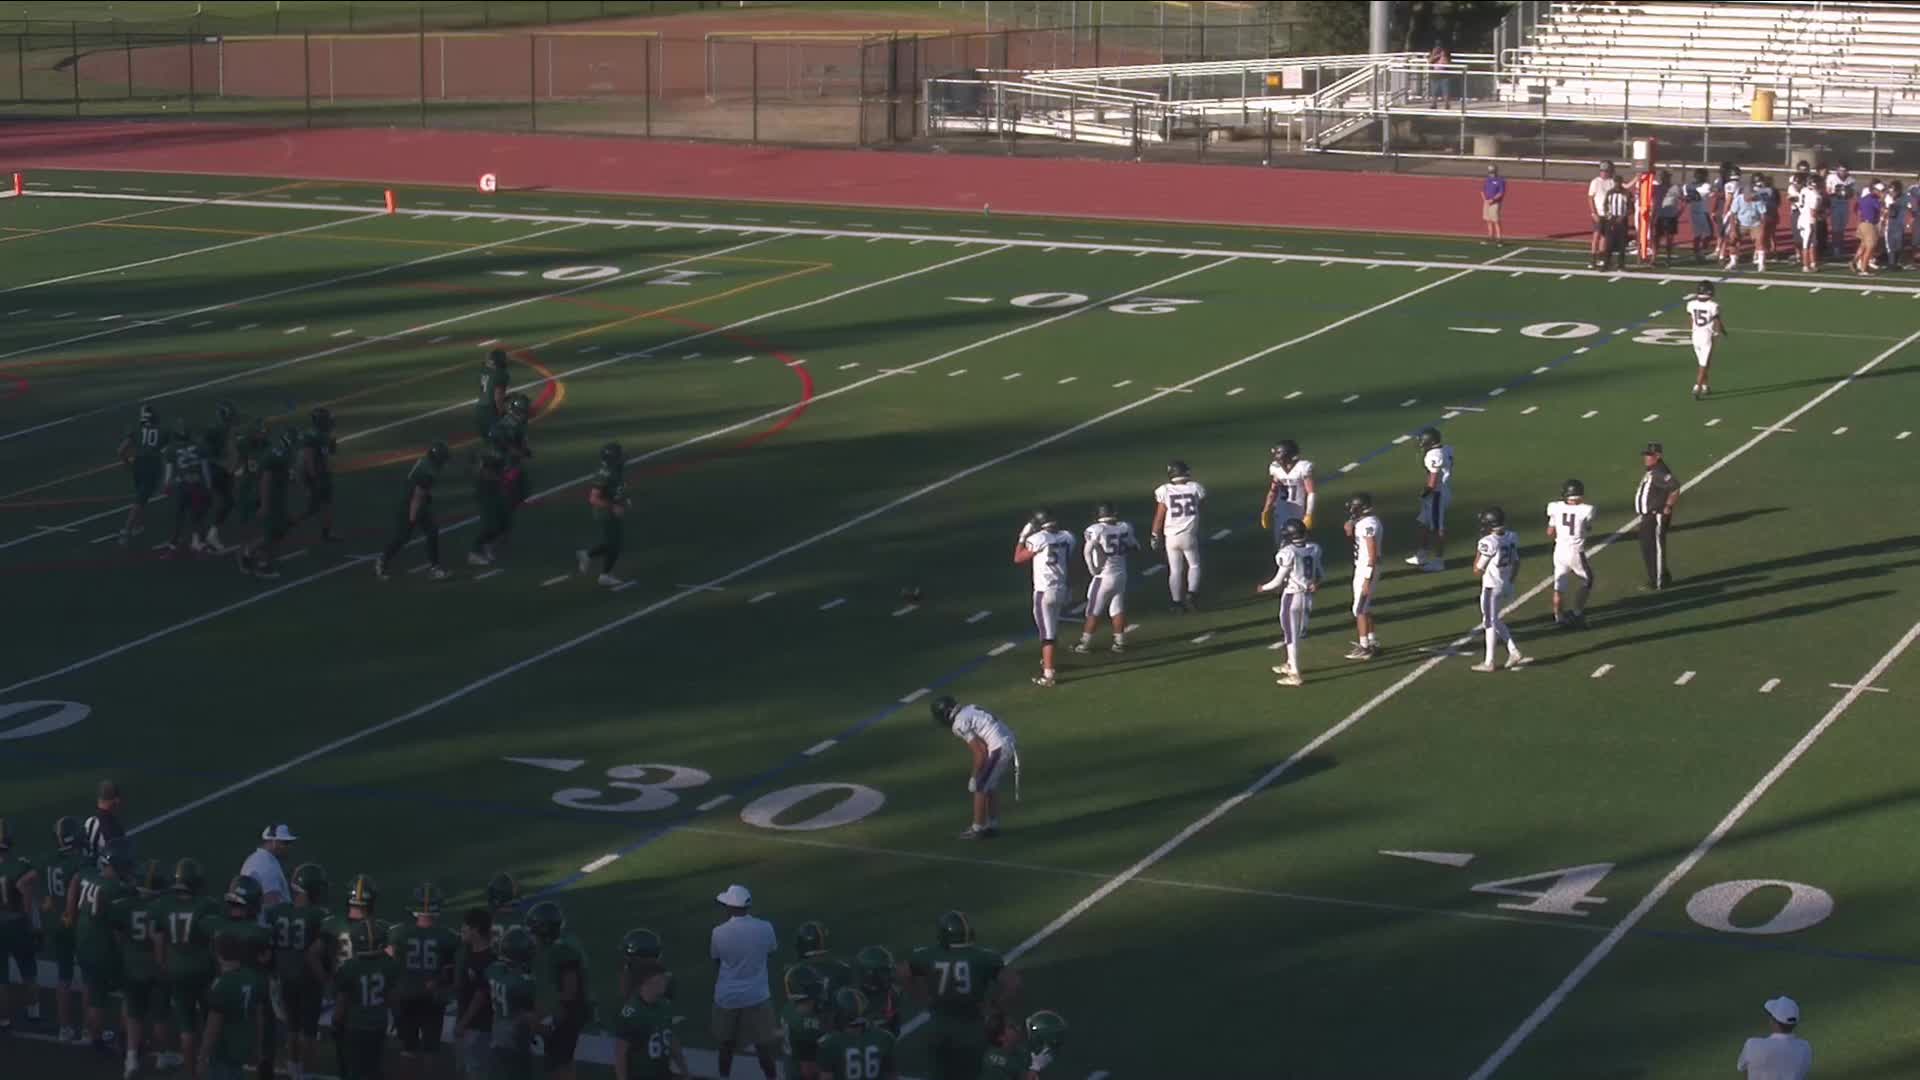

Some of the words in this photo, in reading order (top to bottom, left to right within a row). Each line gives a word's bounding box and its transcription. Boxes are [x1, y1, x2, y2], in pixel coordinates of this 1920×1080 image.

[480, 174, 496, 192] G
[1692, 308, 1708, 326] 15
[142, 428, 158, 447] 10
[1169, 494, 1197, 518] 52
[1562, 513, 1575, 536] 4
[1302, 556, 1314, 580] 8
[48, 865, 65, 896] 16
[79, 879, 99, 915] 74
[168, 911, 194, 943] 17
[277, 915, 305, 950] 33
[407, 938, 438, 970] 26
[360, 973, 385, 1007] 12
[935, 960, 972, 995] 79
[241, 984, 251, 1010] 7
[845, 1046, 880, 1080] 66
